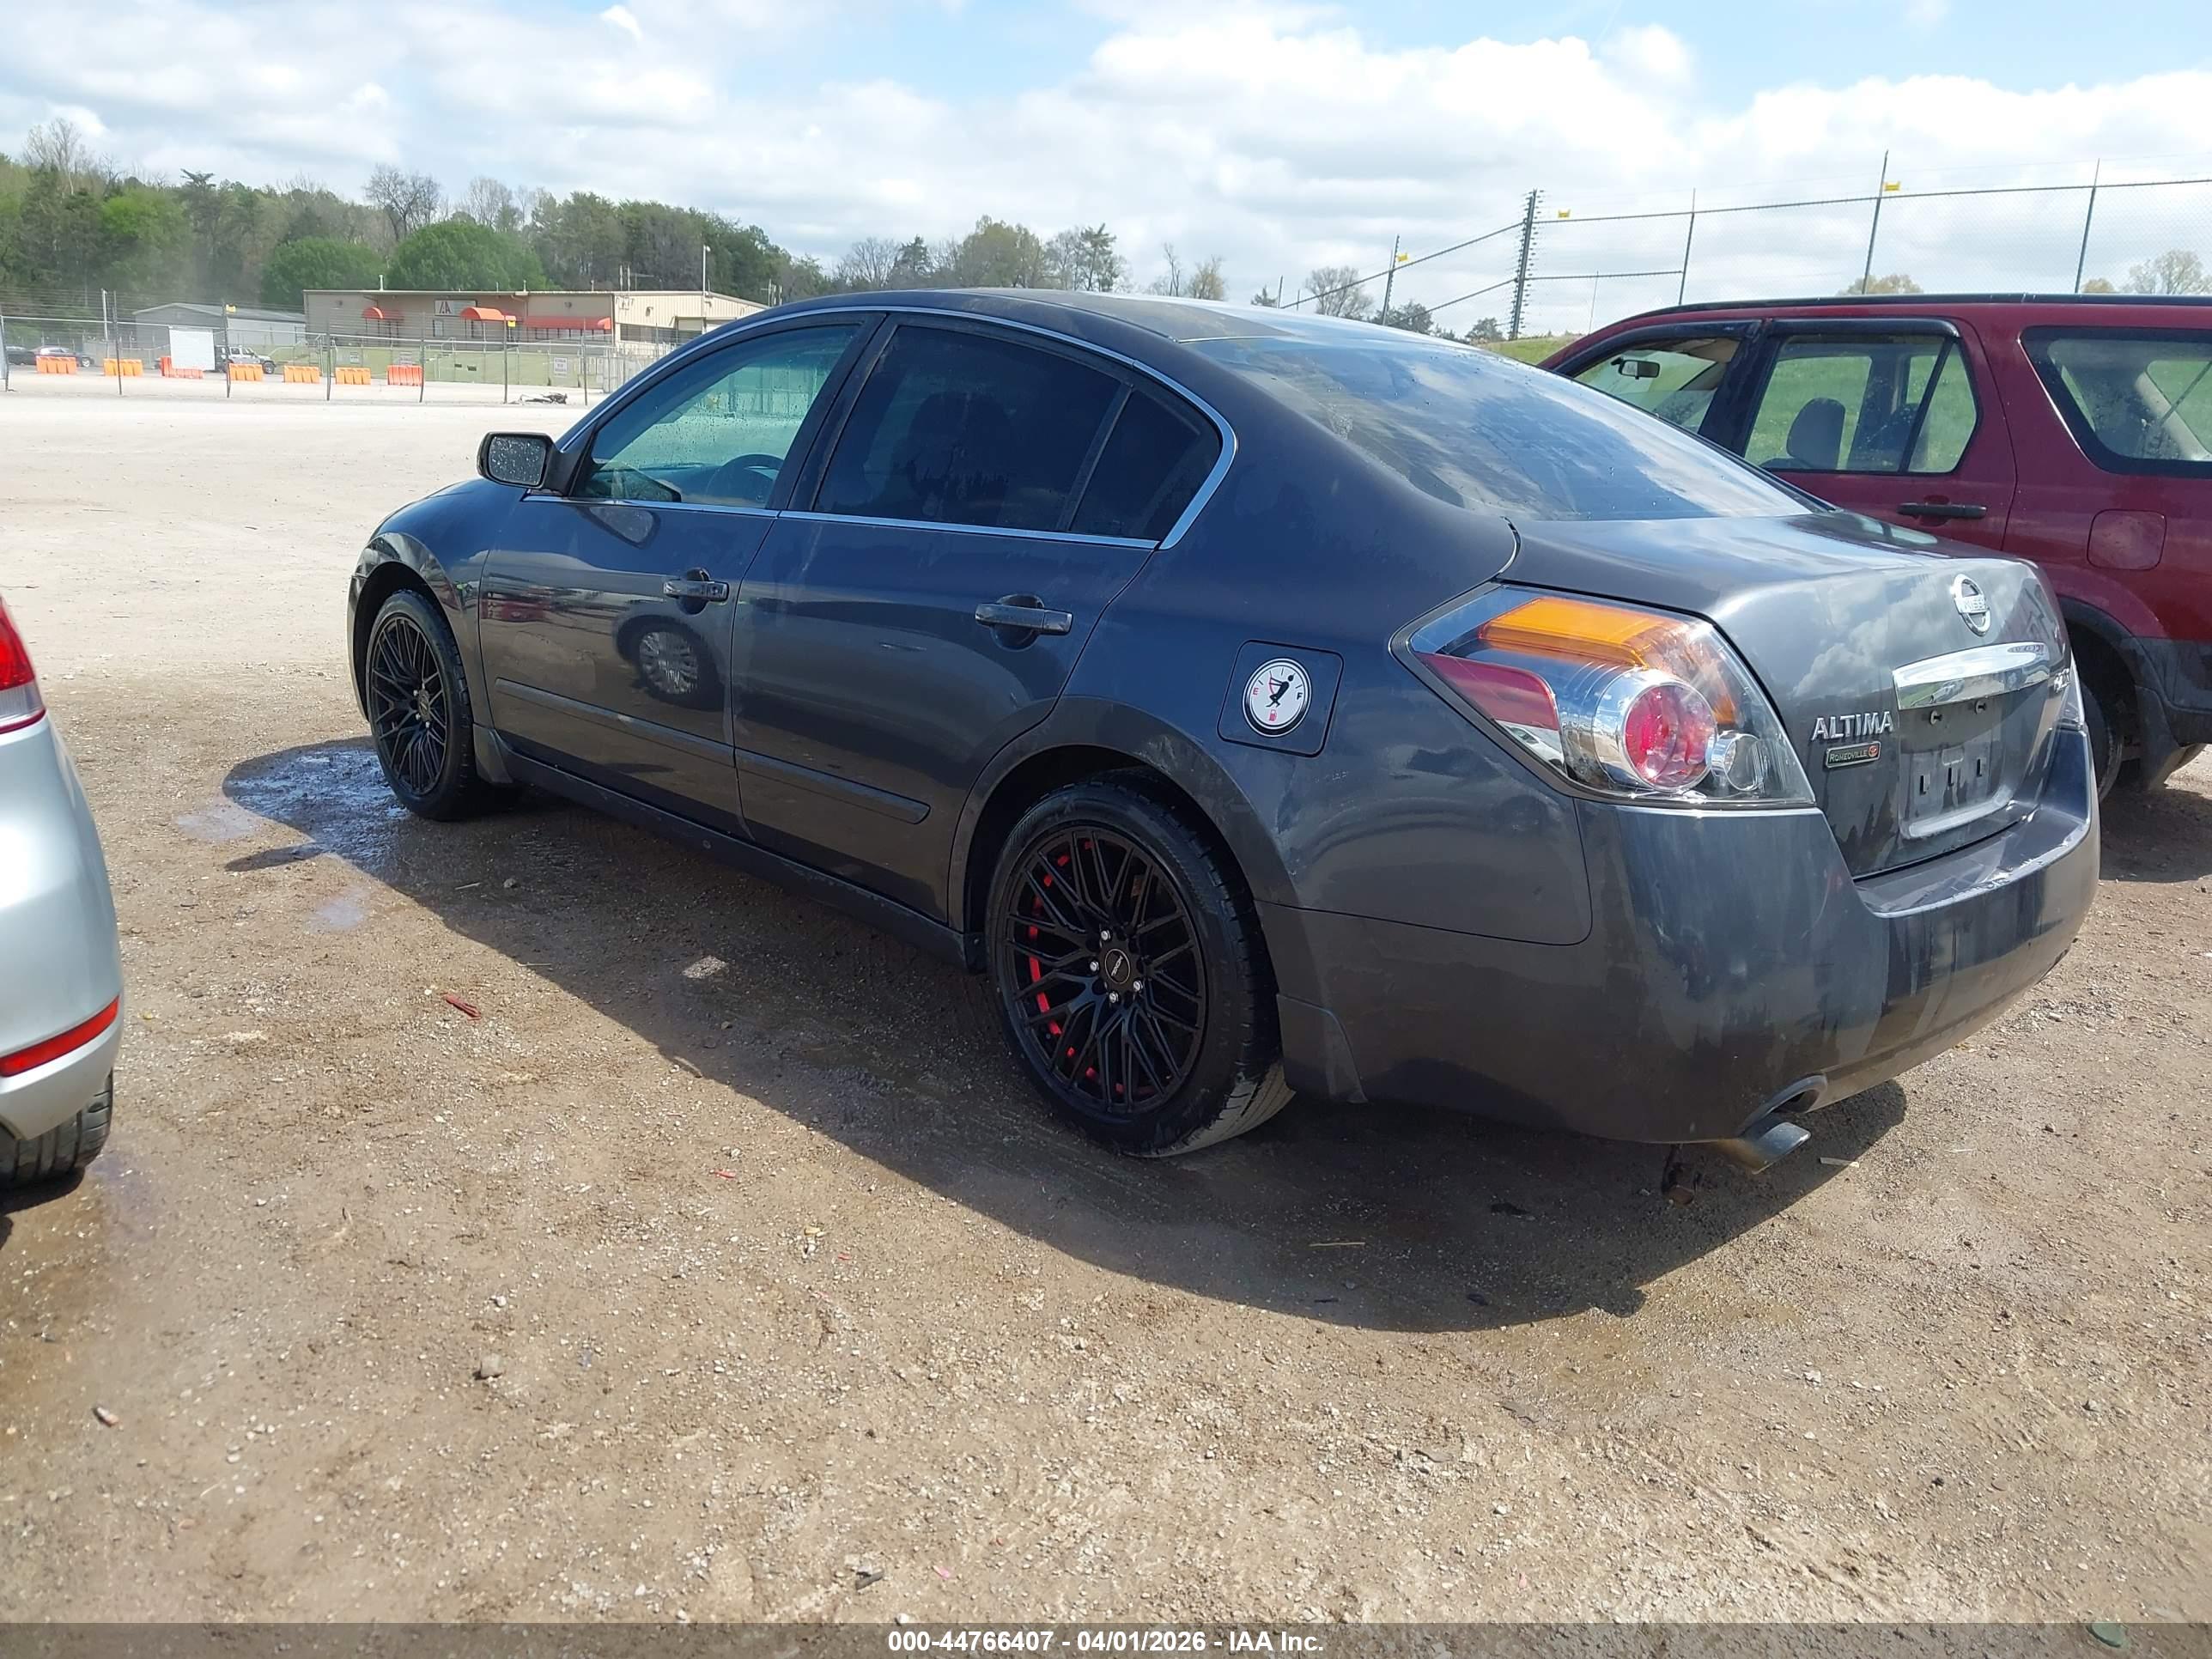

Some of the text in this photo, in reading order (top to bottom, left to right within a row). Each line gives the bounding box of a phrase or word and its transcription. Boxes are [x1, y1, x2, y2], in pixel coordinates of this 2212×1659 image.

[1252, 687, 1260, 696] E
[1297, 692, 1304, 701] F
[1810, 711, 1894, 741] ALTIMA
